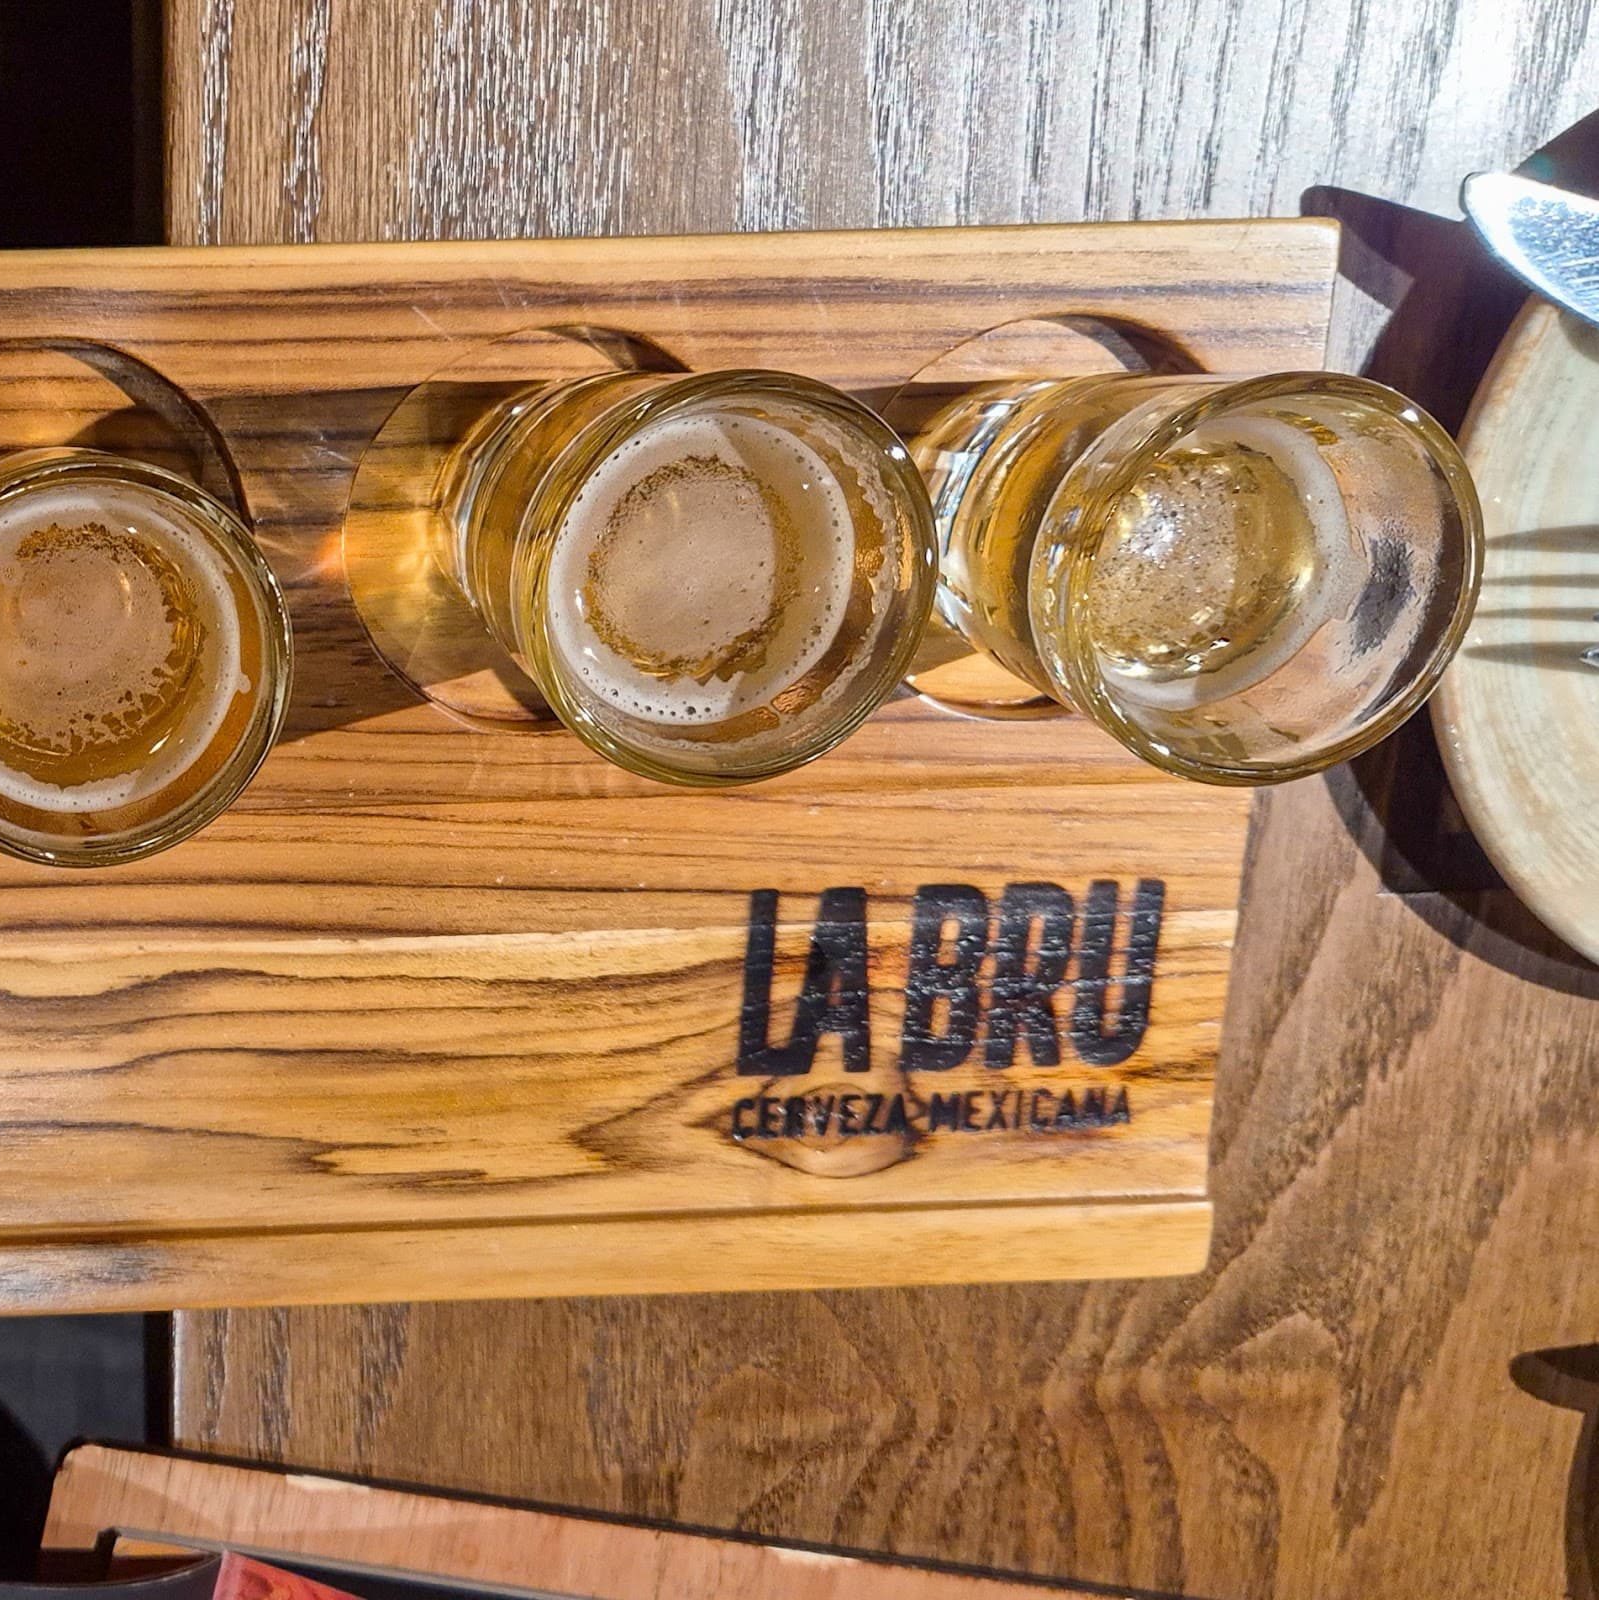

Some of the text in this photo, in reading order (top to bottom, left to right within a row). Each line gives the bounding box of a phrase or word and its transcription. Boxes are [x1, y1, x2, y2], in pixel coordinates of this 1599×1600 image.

[736, 879, 1166, 1076] LA BRU
[731, 1086, 1131, 1142] CERVEZA MEXICANA
